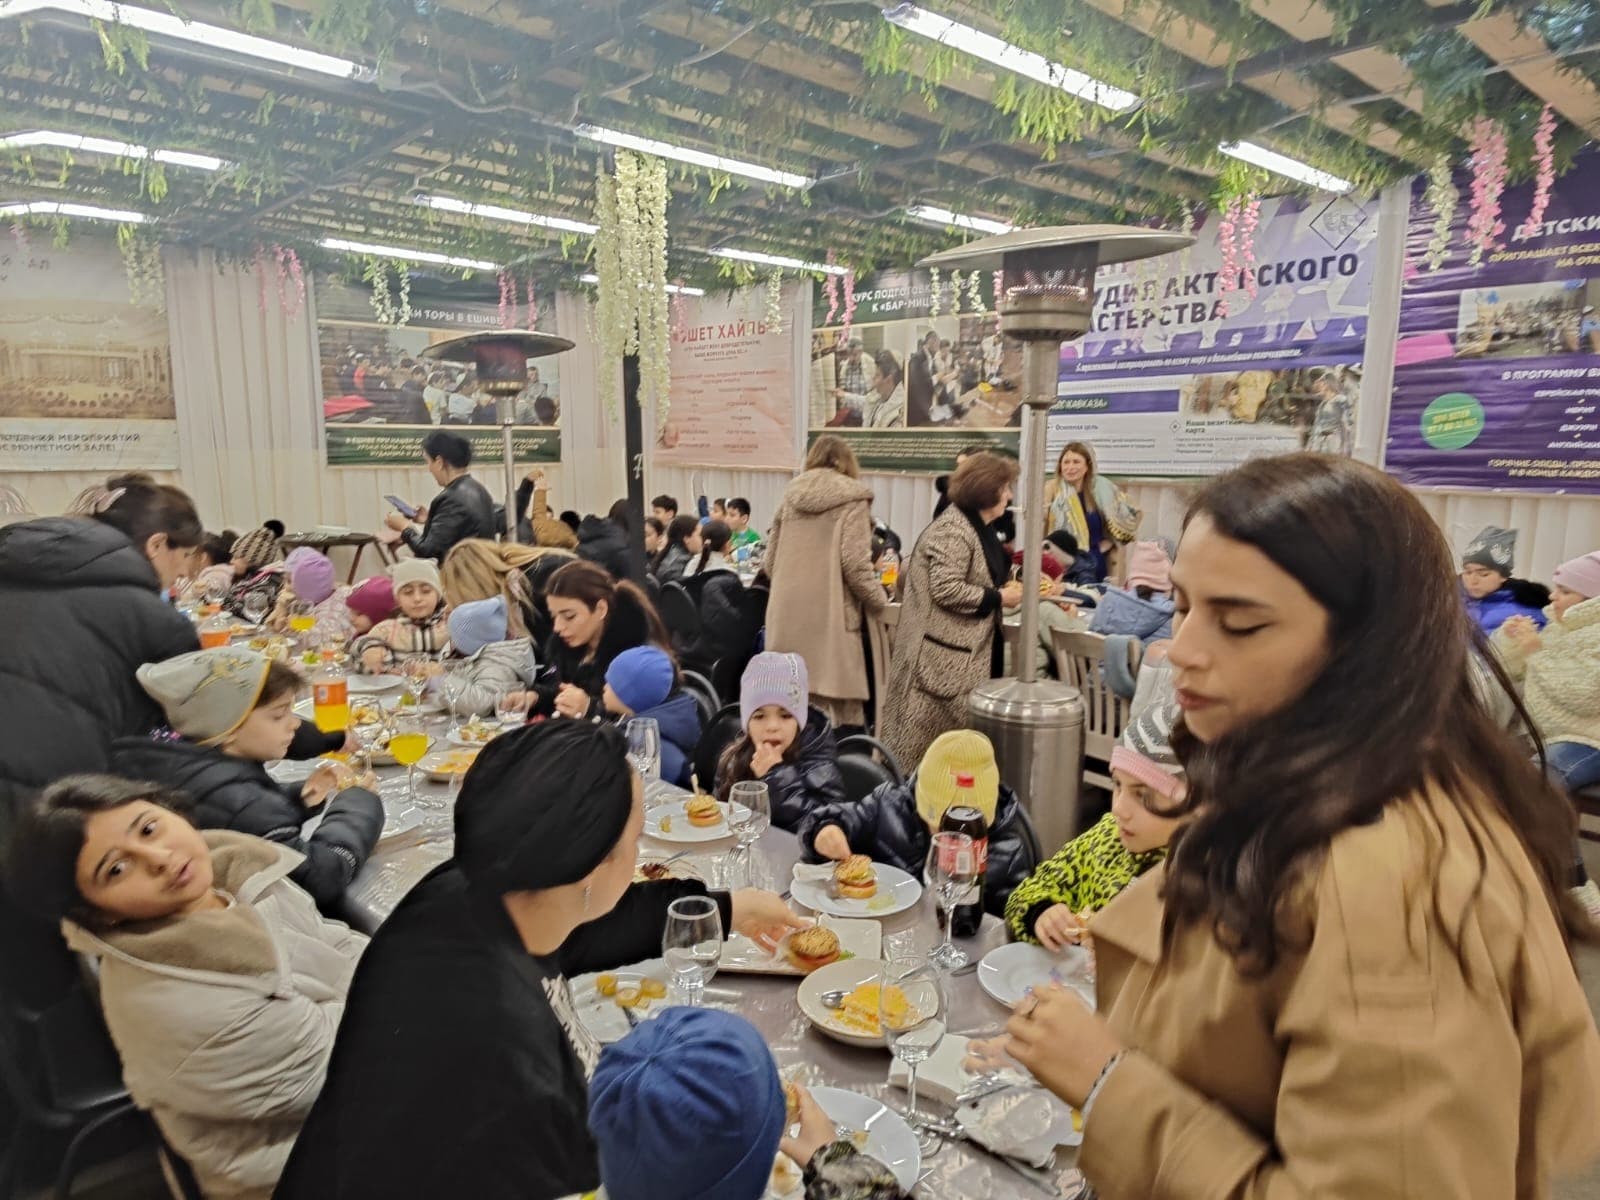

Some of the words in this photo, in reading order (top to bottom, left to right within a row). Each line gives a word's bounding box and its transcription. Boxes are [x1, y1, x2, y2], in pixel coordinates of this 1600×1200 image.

[1488, 246, 1568, 263] ПРИГЛАШАЕТ
[1164, 253, 1359, 300] АКТРСКОГО
[424, 309, 455, 321] ТОРЫ
[457, 312, 464, 323] В
[872, 303, 879, 314] К
[1090, 300, 1226, 333] СТЕРСТВА
[1512, 368, 1588, 380] ПРОГРАММУ
